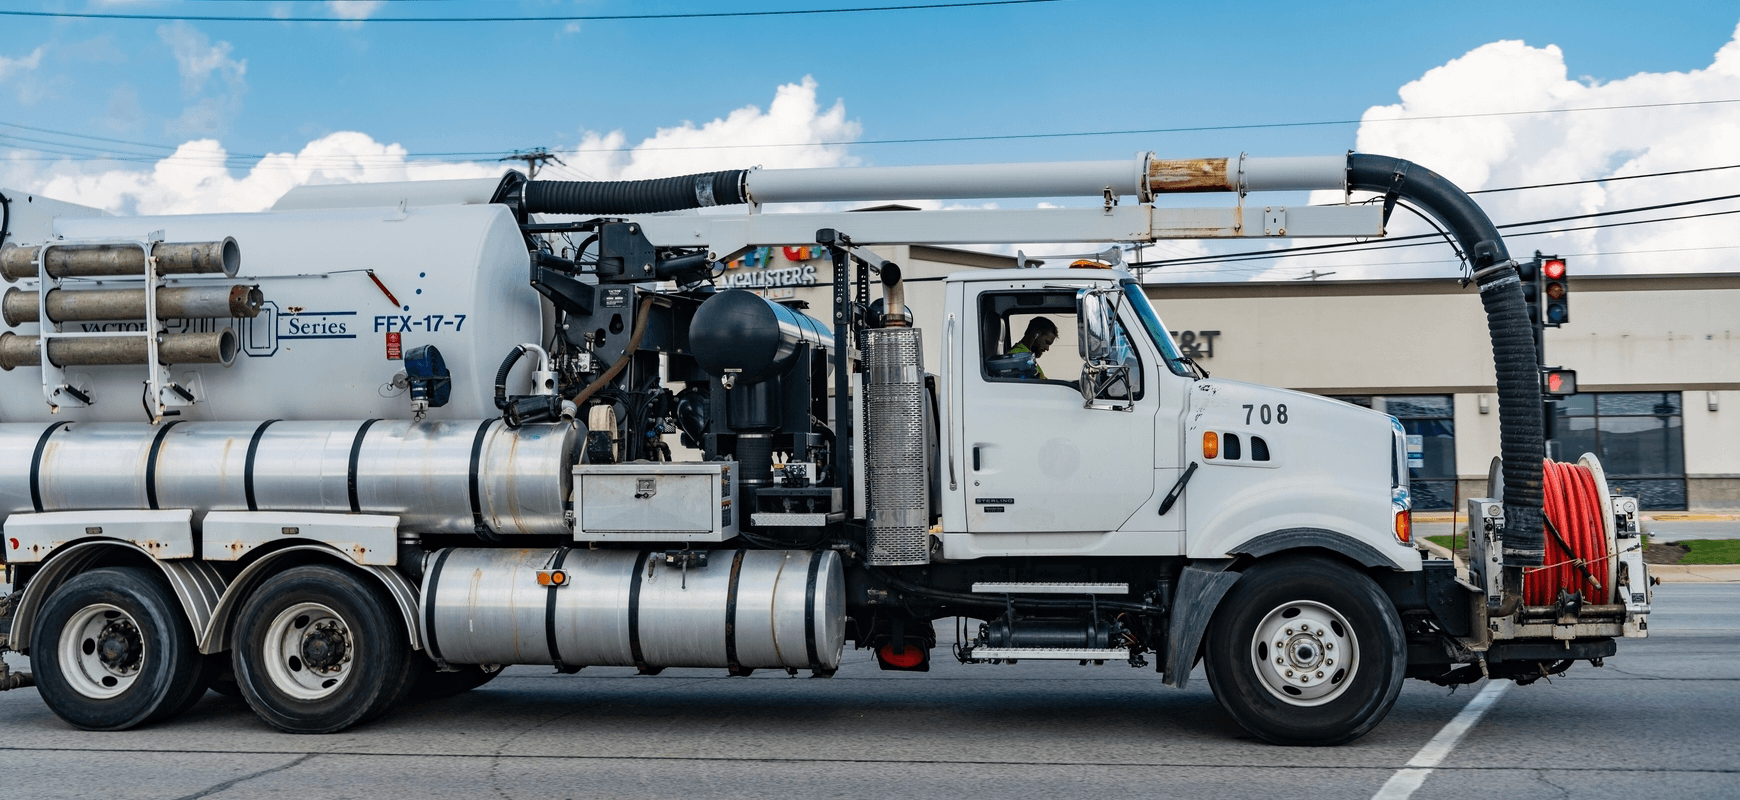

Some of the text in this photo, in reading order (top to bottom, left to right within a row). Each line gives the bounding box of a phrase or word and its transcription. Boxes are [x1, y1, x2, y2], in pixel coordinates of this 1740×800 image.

[289, 317, 347, 335] Series
[374, 314, 466, 333] FFX-17-7
[1242, 404, 1288, 425] 708
